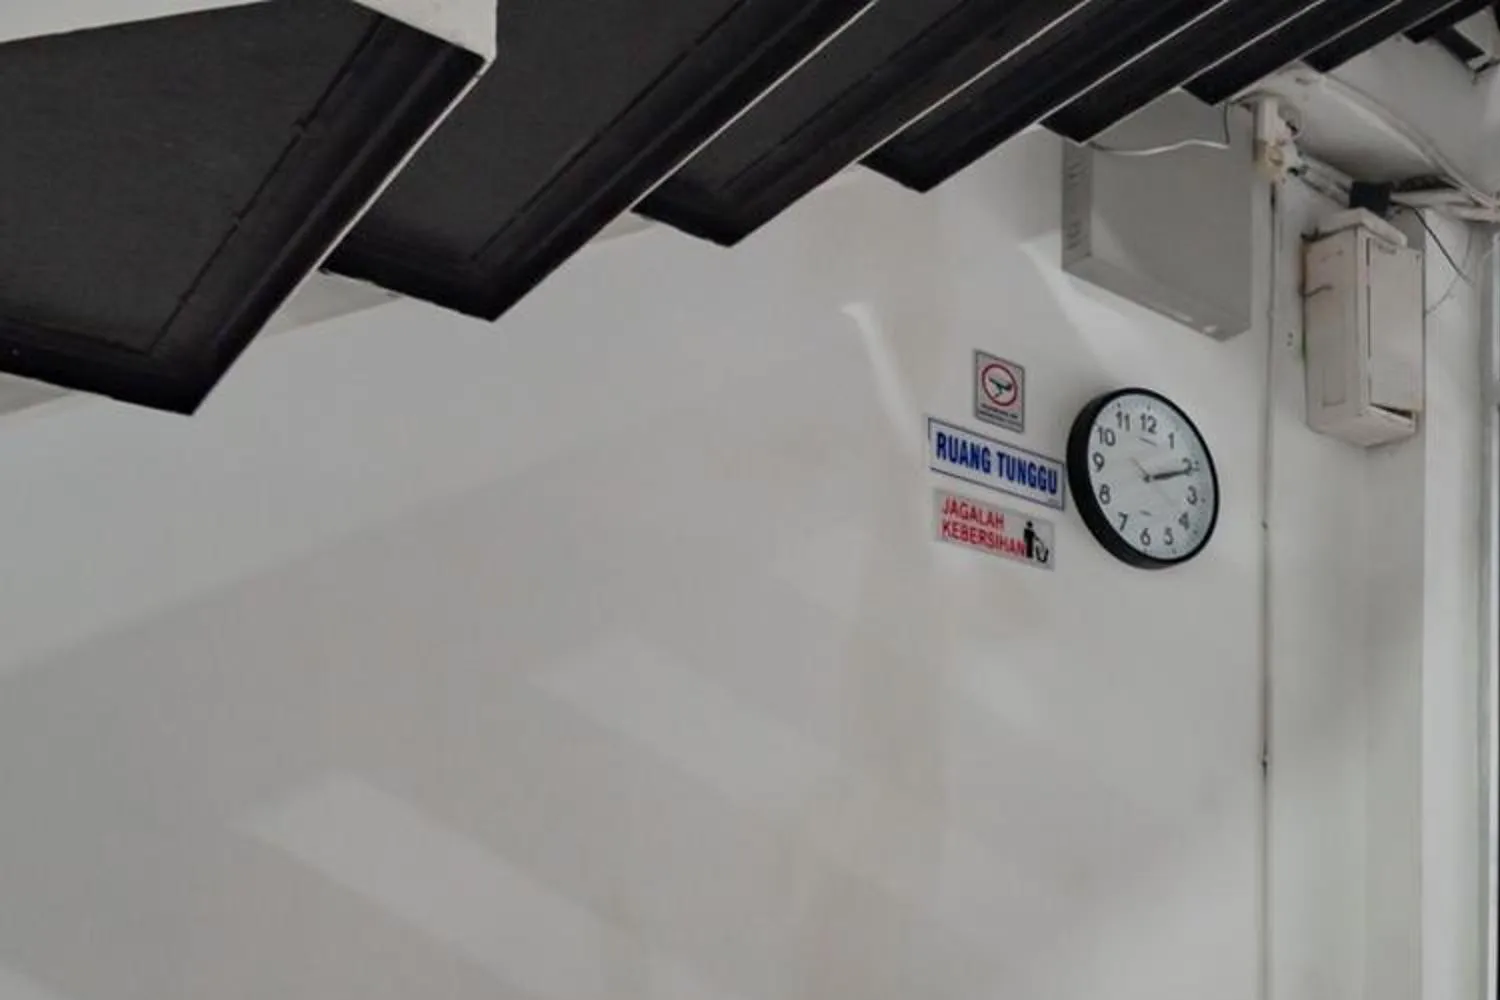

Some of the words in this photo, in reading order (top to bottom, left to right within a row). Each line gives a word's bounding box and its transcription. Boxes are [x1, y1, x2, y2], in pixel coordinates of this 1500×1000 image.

[1116, 411, 1130, 431] 11
[1140, 413, 1157, 434] 12
[1098, 427, 1116, 446] 10
[1168, 432, 1175, 449] 1
[936, 432, 991, 474] RUANG
[997, 452, 1058, 494] TUNGGU
[1093, 452, 1105, 472] 9
[1182, 457, 1193, 475] 2
[1099, 484, 1111, 505] 8
[1187, 485, 1198, 505] 3
[943, 497, 1004, 528] JAGALAH
[1118, 512, 1128, 531] 7
[1178, 512, 1190, 531] 4
[941, 520, 1025, 557] KEBERSIHAN
[1140, 527, 1151, 546] 6
[1163, 527, 1174, 546] 5
